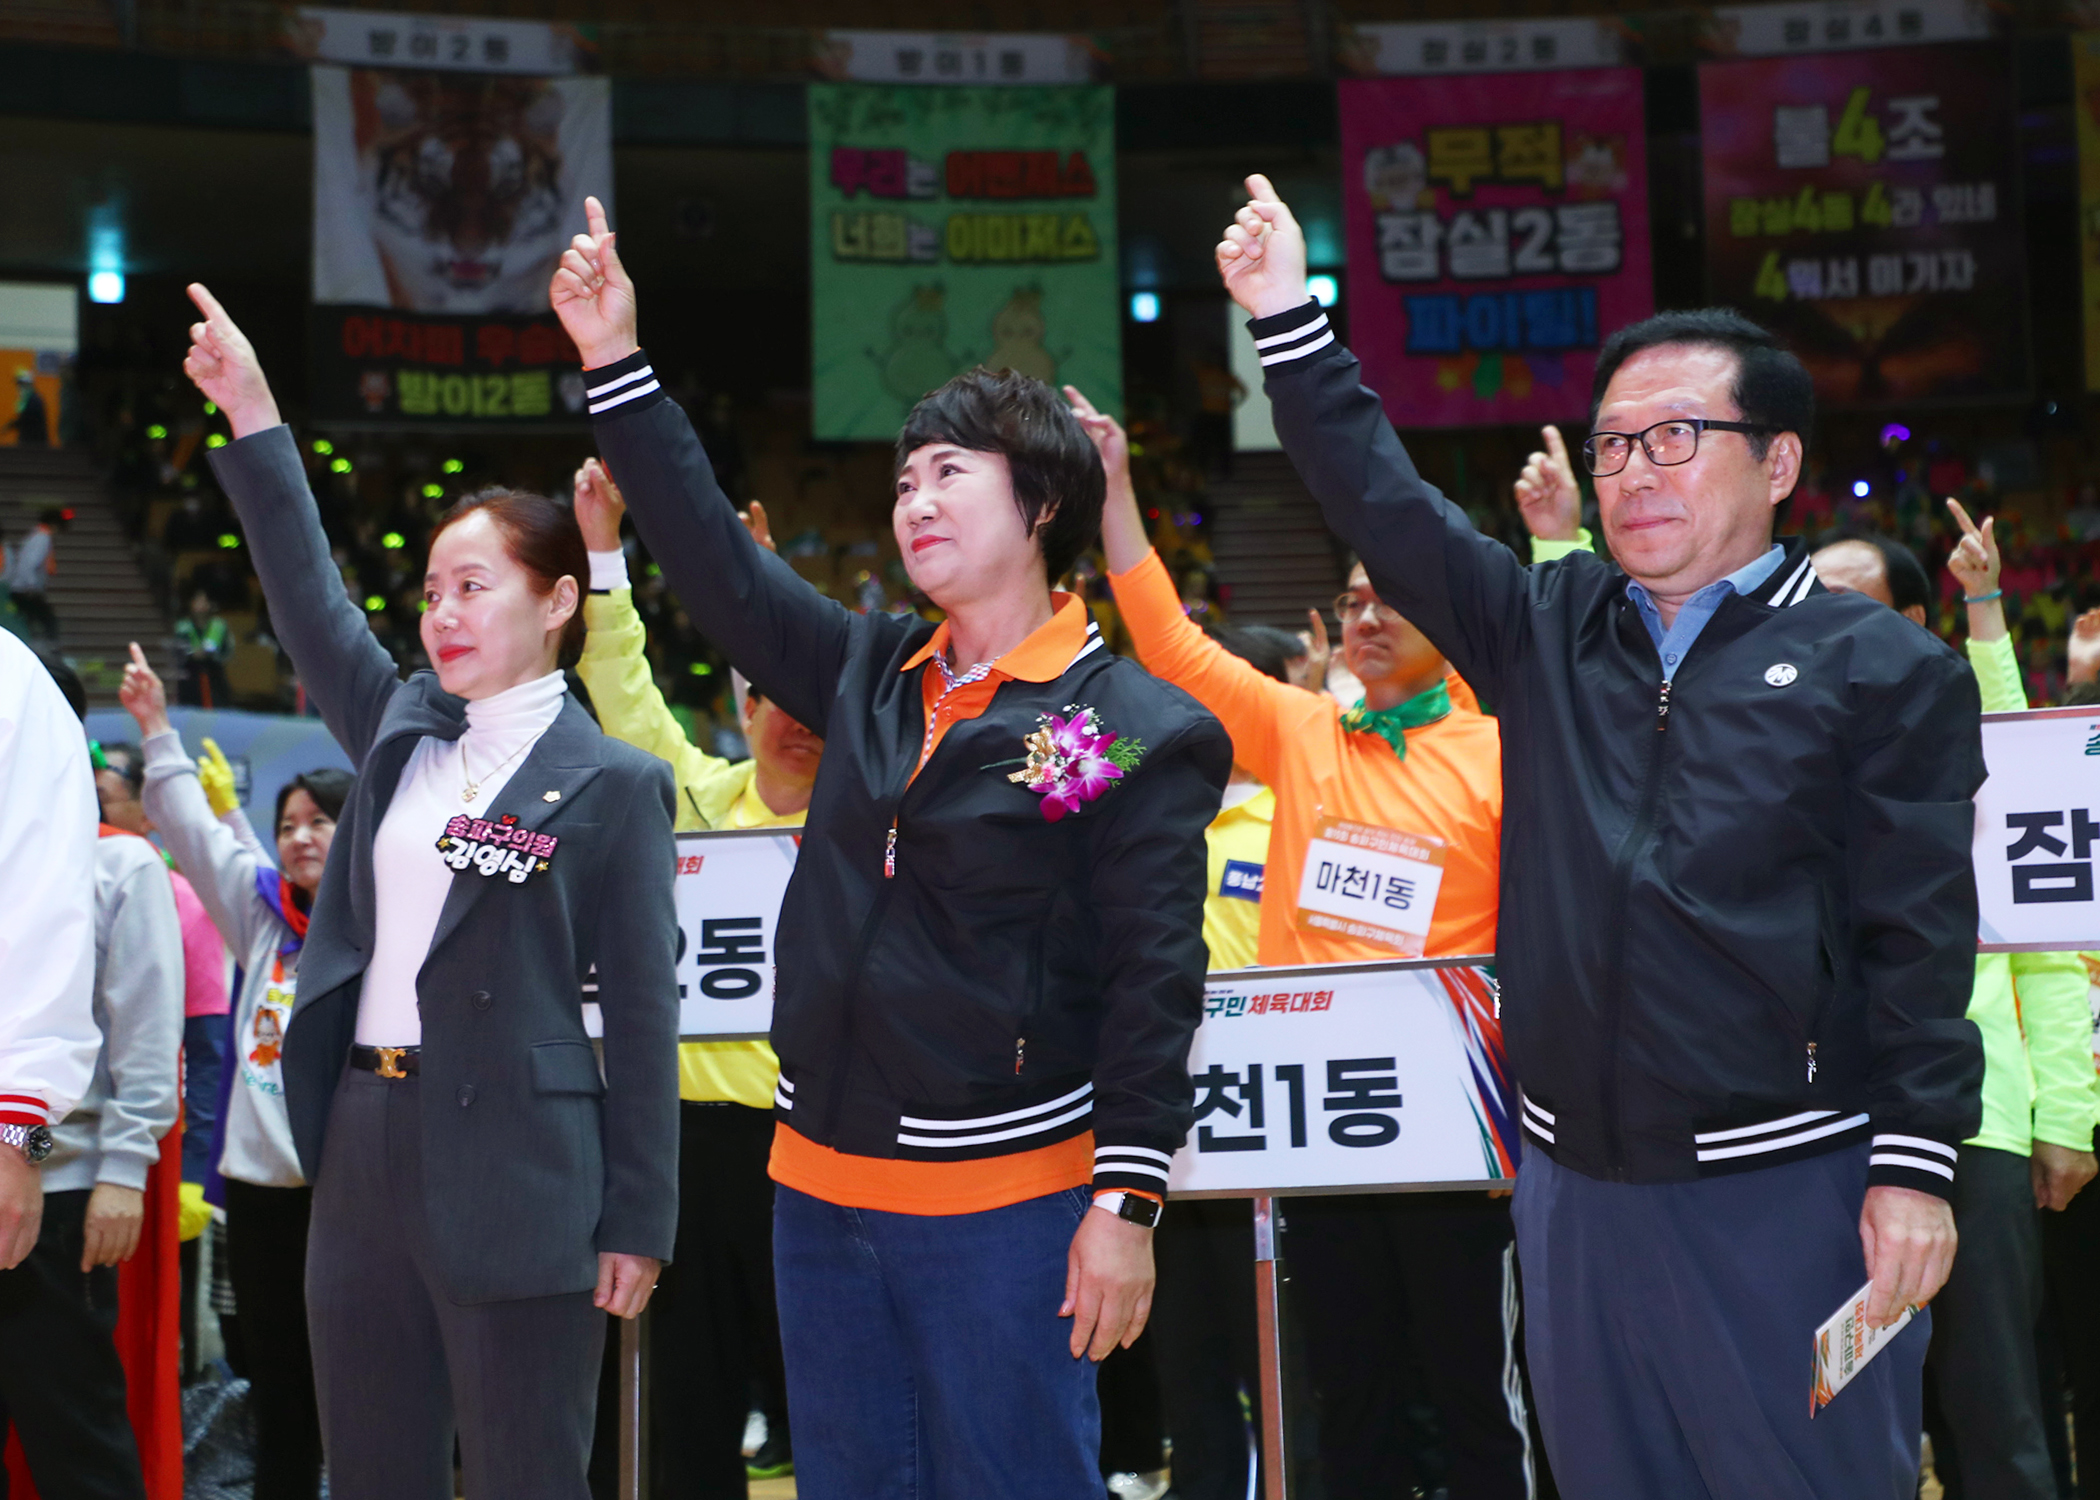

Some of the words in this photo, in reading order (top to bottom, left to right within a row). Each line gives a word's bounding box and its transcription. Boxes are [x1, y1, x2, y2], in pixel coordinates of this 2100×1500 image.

[1376, 202, 1622, 281] 잠실2동
[397, 369, 550, 417] 방이2동
[445, 815, 558, 858] 송파구의원
[446, 836, 538, 884] 김영심
[2006, 808, 2100, 905] 잠
[1316, 861, 1416, 911] 마천1동
